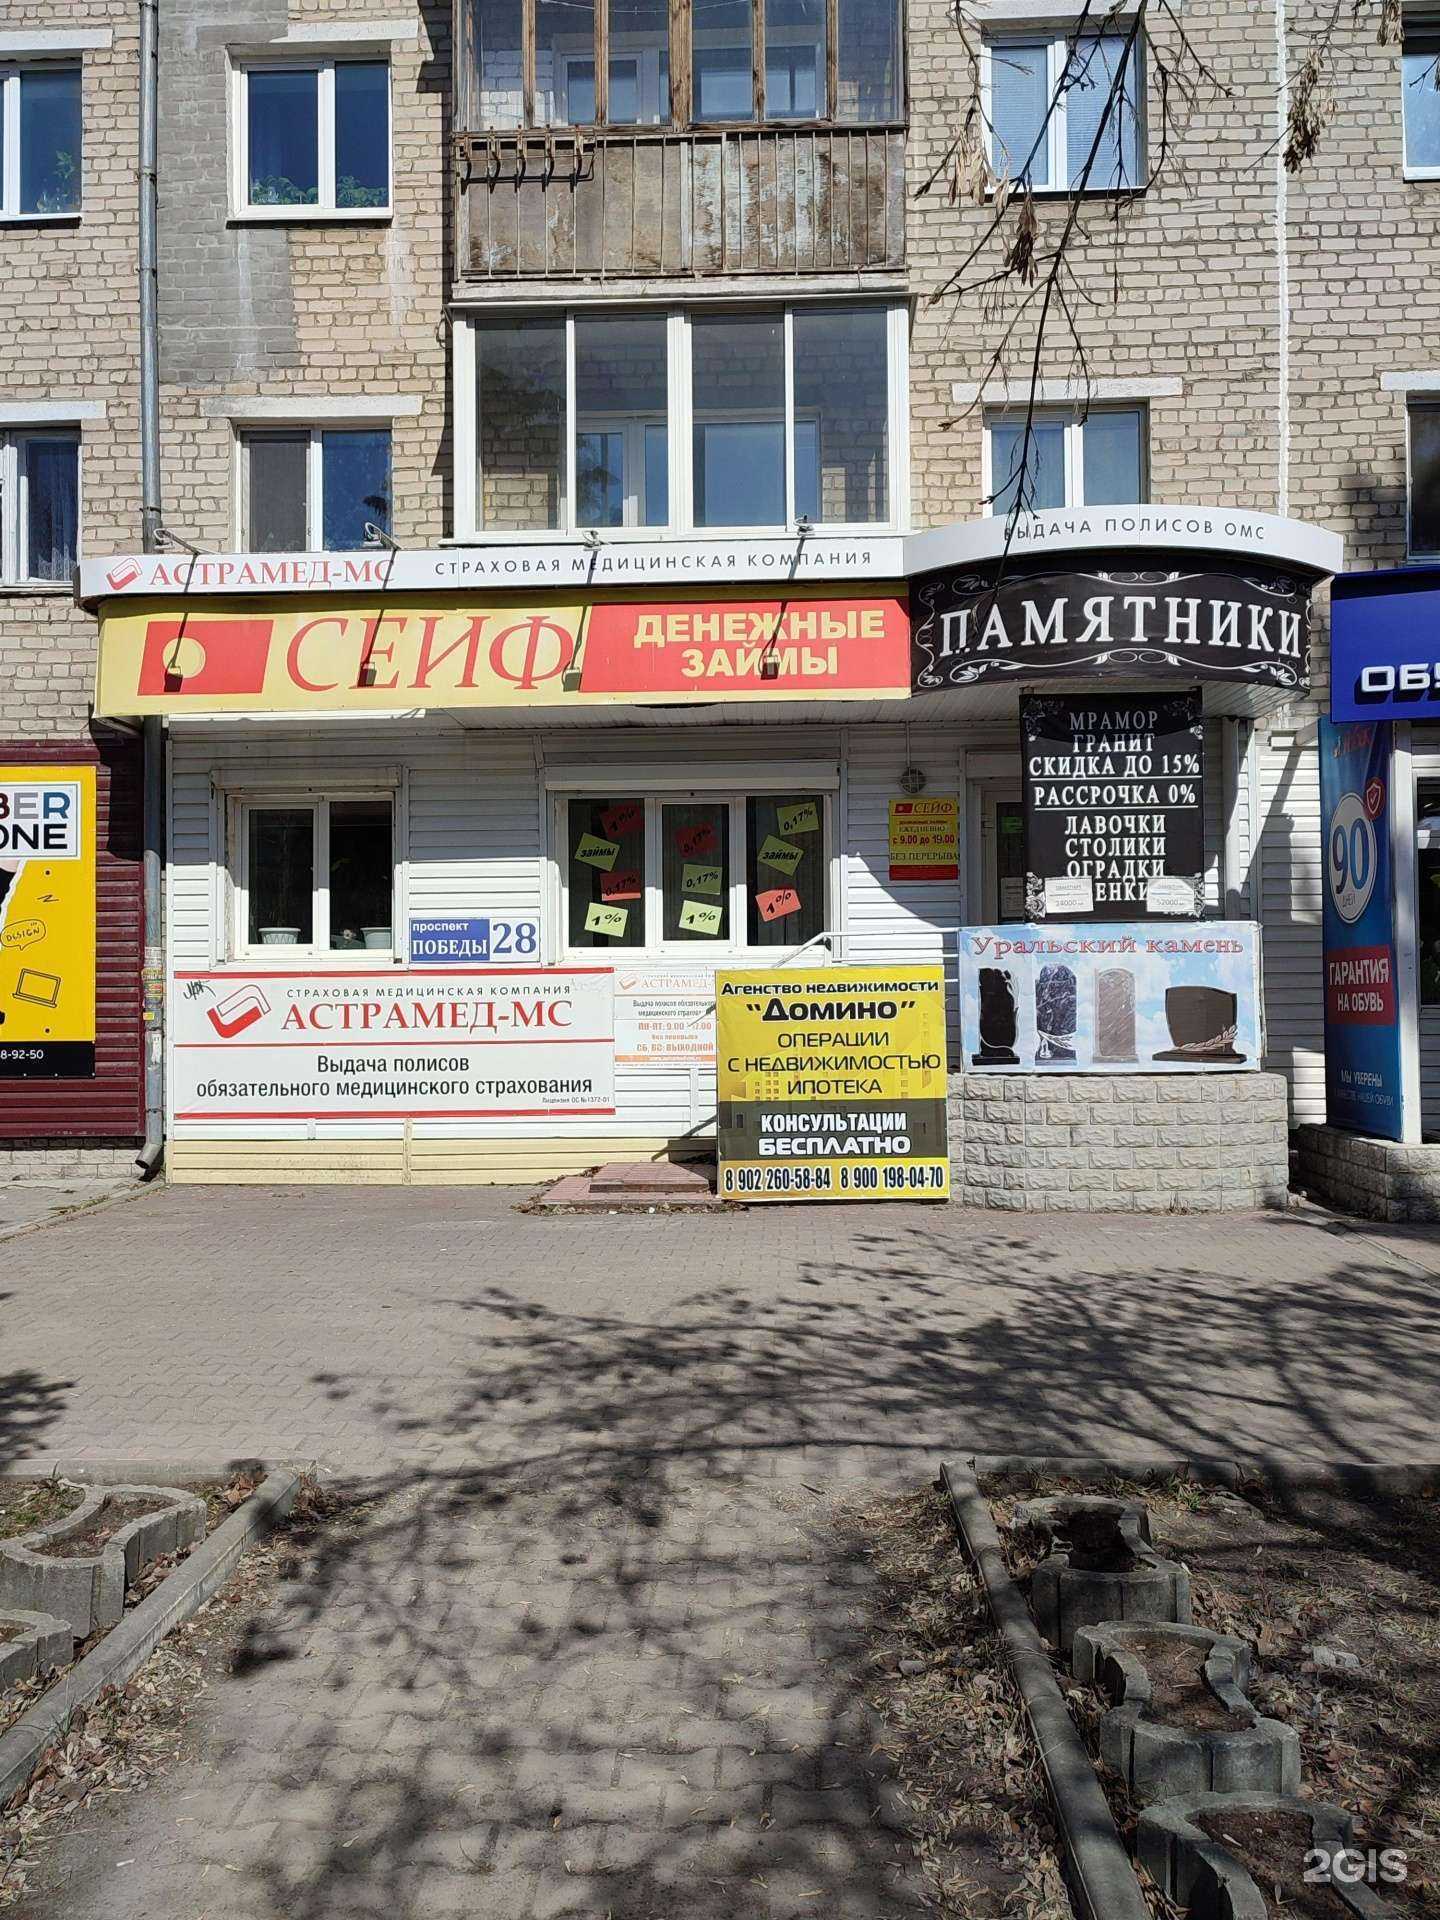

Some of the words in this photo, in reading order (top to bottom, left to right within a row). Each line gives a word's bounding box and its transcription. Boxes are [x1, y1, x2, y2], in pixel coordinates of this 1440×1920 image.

[1004, 520, 1091, 541] ВЫДАЧА
[1105, 518, 1213, 534] ПОЛИСОВ
[1225, 522, 1265, 540] ОМС
[149, 559, 395, 589] АСТРАМЕД-МС
[435, 559, 561, 575] СТРАХОВАЯ
[571, 555, 736, 573] МЕДИЦИНСКАЯ
[748, 551, 872, 567] КОМПАНИЯ
[633, 609, 885, 649] ДЕНЕЖНЫЕ
[938, 595, 1302, 659] ПАМЯТНИКИ
[681, 641, 838, 678] ЗАЙМЫ
[1361, 662, 1440, 692] ОБ
[1069, 710, 1159, 731] МРАМОР
[1072, 732, 1156, 753] ГРАНИТ
[1029, 755, 1116, 779] СКИДКА
[1124, 754, 1152, 778] ДО
[1162, 753, 1200, 775] 15%
[1034, 784, 1161, 806] РАССРОЧКА
[1168, 783, 1197, 804] 0%
[783, 806, 813, 831] 0,17%
[1064, 814, 1167, 835] ЛАВОЧКИ
[899, 834, 918, 845] 9.00
[920, 836, 930, 846] до
[931, 834, 955, 844] 19.00
[1065, 837, 1167, 857] СТОЛИКИ
[580, 846, 616, 858] займы
[762, 849, 799, 860] займы
[1332, 817, 1370, 895] 90
[686, 870, 719, 888] 0,17%
[1066, 859, 1166, 883] ОГРАДКИ
[766, 888, 792, 914] 1%
[1094, 881, 1149, 902] ЕНКИ
[591, 912, 622, 926] 1%
[686, 909, 716, 925] 1%
[412, 922, 470, 934] проспект
[492, 922, 537, 954] 28
[412, 939, 488, 958] ПОБЕДЫ
[971, 935, 1137, 960] Уральский
[1145, 937, 1245, 954] камень
[1328, 958, 1390, 987] ГАРАНТИЯ
[286, 987, 370, 998] СТРАХОВАЯ
[376, 986, 484, 998] МЕДИЦИНСКАЯ
[490, 985, 572, 996] КОМПАНИЯ
[721, 982, 803, 995] Агенство
[806, 981, 939, 995] недвижимости
[1337, 992, 1350, 1012] НА
[1352, 991, 1384, 1012] ОБУВЬ
[281, 1000, 574, 1035] АСТРАМЕД-МС
[777, 1031, 890, 1048] ОПЕРАЦИИ
[316, 1055, 389, 1076] Выдача
[394, 1056, 470, 1073] полисов
[728, 1057, 740, 1072] С
[745, 1054, 941, 1072] НЕДВИЖИМОСТЬЮ
[196, 1078, 331, 1098] обязательного
[335, 1080, 470, 1099] медицинского
[475, 1079, 593, 1098] страхования
[787, 1078, 883, 1095] ИПОТЕКА
[760, 1112, 908, 1134] КОНСУЛЬТАЦИИ
[758, 1136, 912, 1156] БЕСПЛАТНО
[725, 1169, 734, 1190] 8
[738, 1168, 762, 1190] 902
[766, 1167, 831, 1189] 260-58-84
[840, 1166, 848, 1188] 8
[853, 1166, 878, 1188] 900
[882, 1165, 944, 1188] 198-04-70
